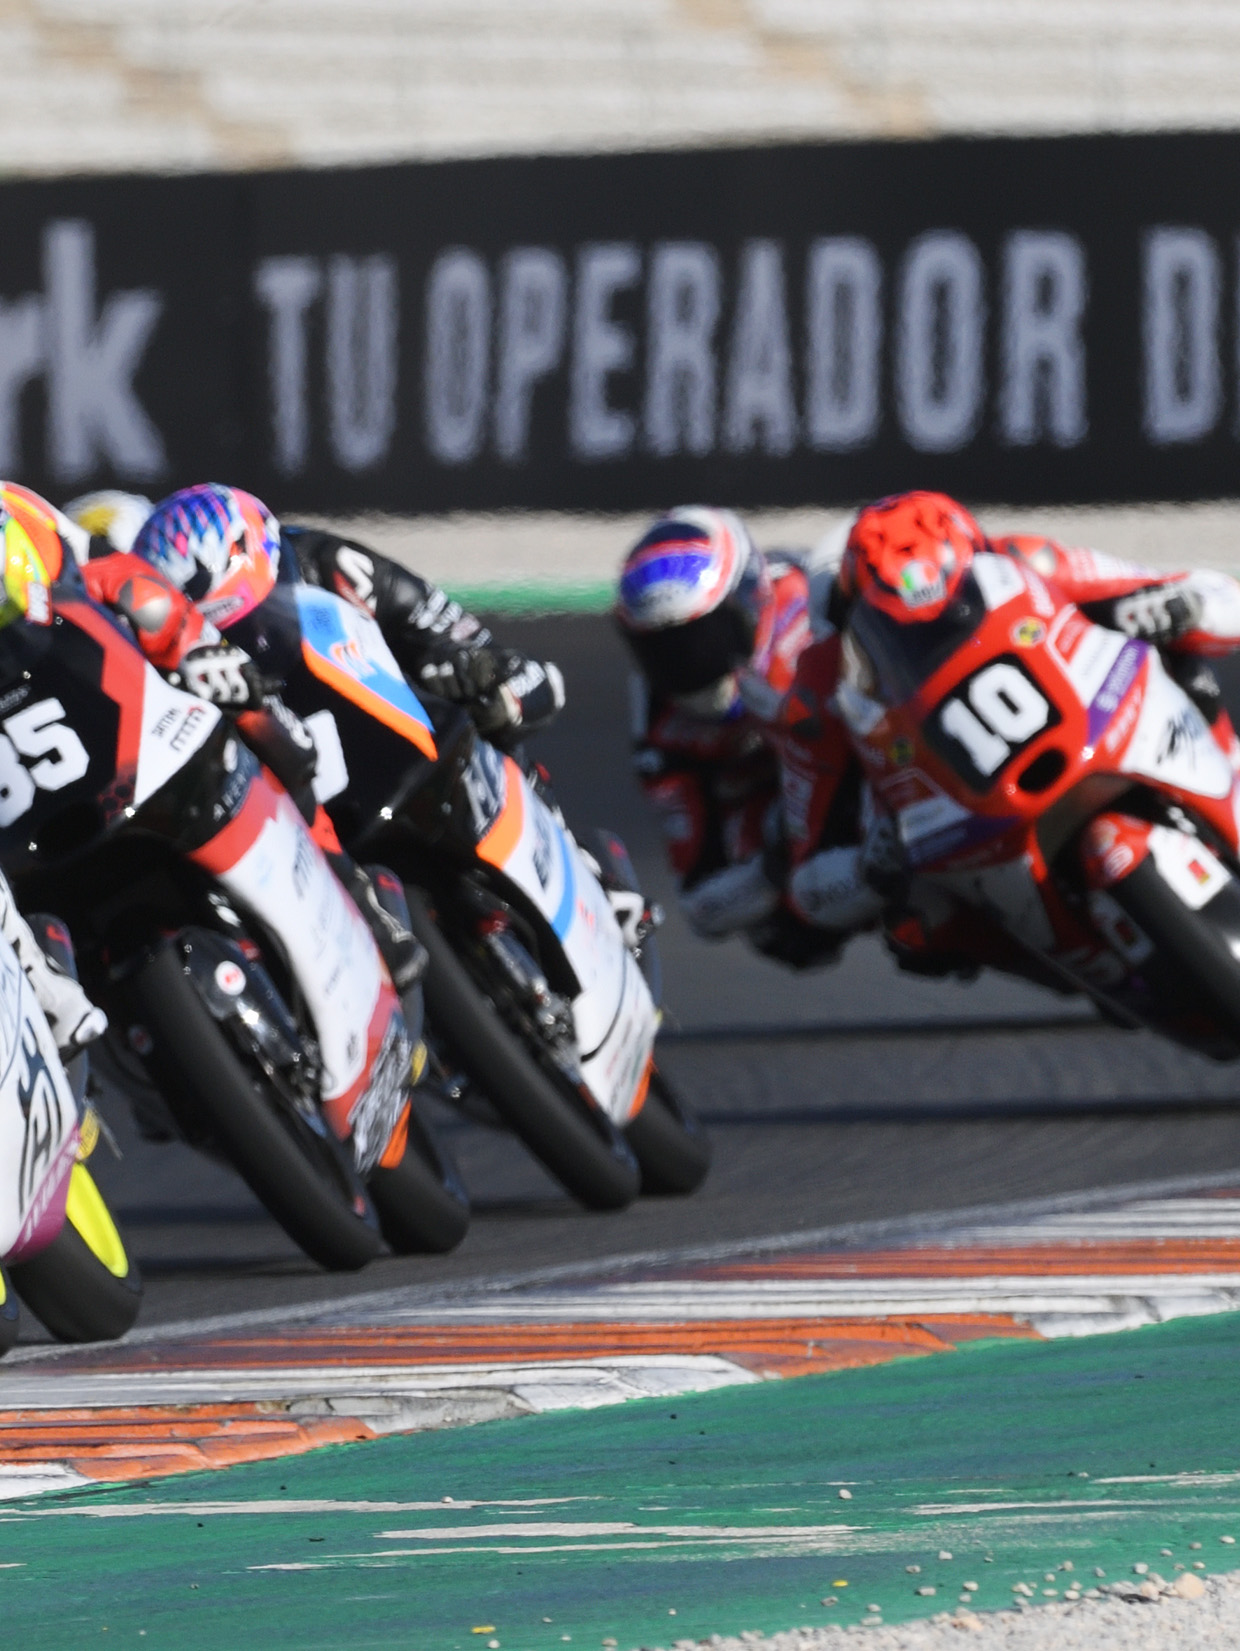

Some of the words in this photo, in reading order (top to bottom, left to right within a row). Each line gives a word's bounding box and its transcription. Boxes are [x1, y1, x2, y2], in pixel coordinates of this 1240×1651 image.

[257, 254, 399, 475] TU
[423, 226, 1088, 465] OPERADOR
[1142, 226, 1240, 446] D
[941, 663, 1050, 777] 10
